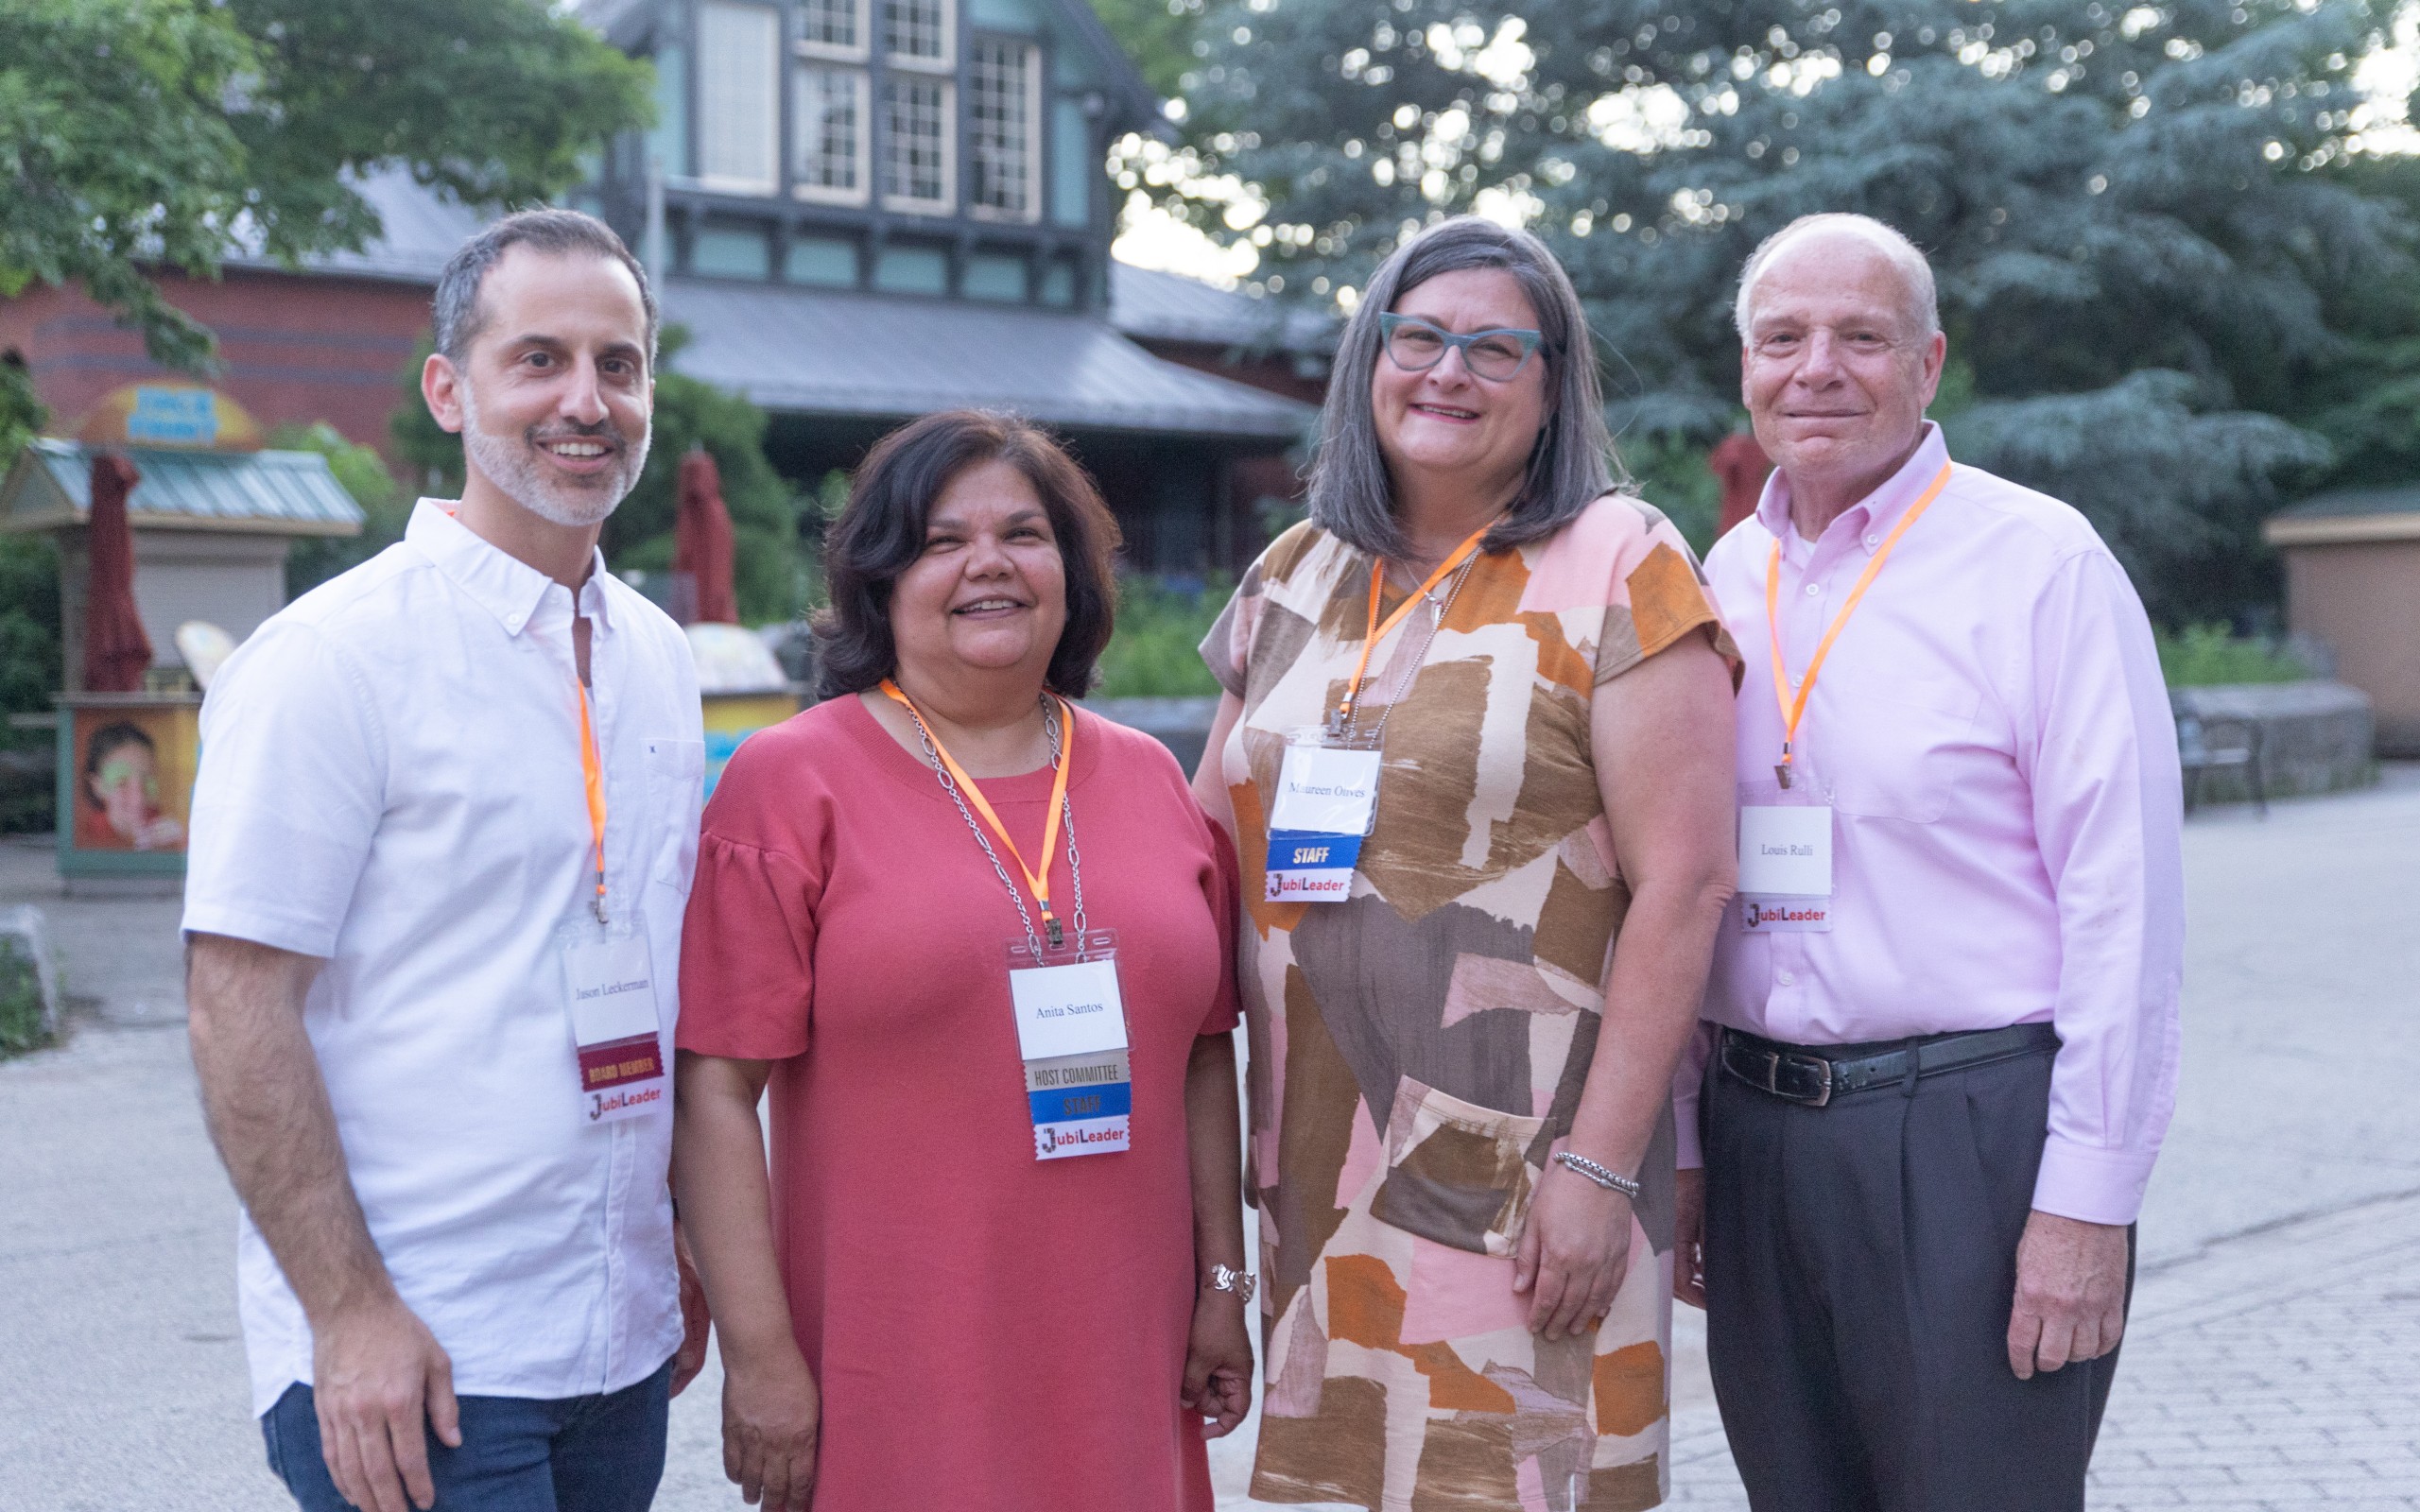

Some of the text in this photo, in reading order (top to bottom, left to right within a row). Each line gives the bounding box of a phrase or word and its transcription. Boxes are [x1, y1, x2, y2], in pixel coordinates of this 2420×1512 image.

[1288, 782, 1332, 796] Maureen
[1292, 847, 1331, 864] STAFF
[1760, 844, 1813, 856] Louis Rulli
[1270, 872, 1344, 897] JubiLeader
[1747, 902, 1826, 928] JubiLeader
[576, 979, 649, 1001] Jason Leckerman
[1035, 1002, 1104, 1020] Anita Santos
[589, 1057, 655, 1083] BOARD MEMBER
[1034, 1064, 1118, 1087] HOST COMMITTEE
[590, 1088, 661, 1121] JubiLeader
[1063, 1095, 1102, 1116] STAFF
[1041, 1126, 1125, 1154] JubiLeader
